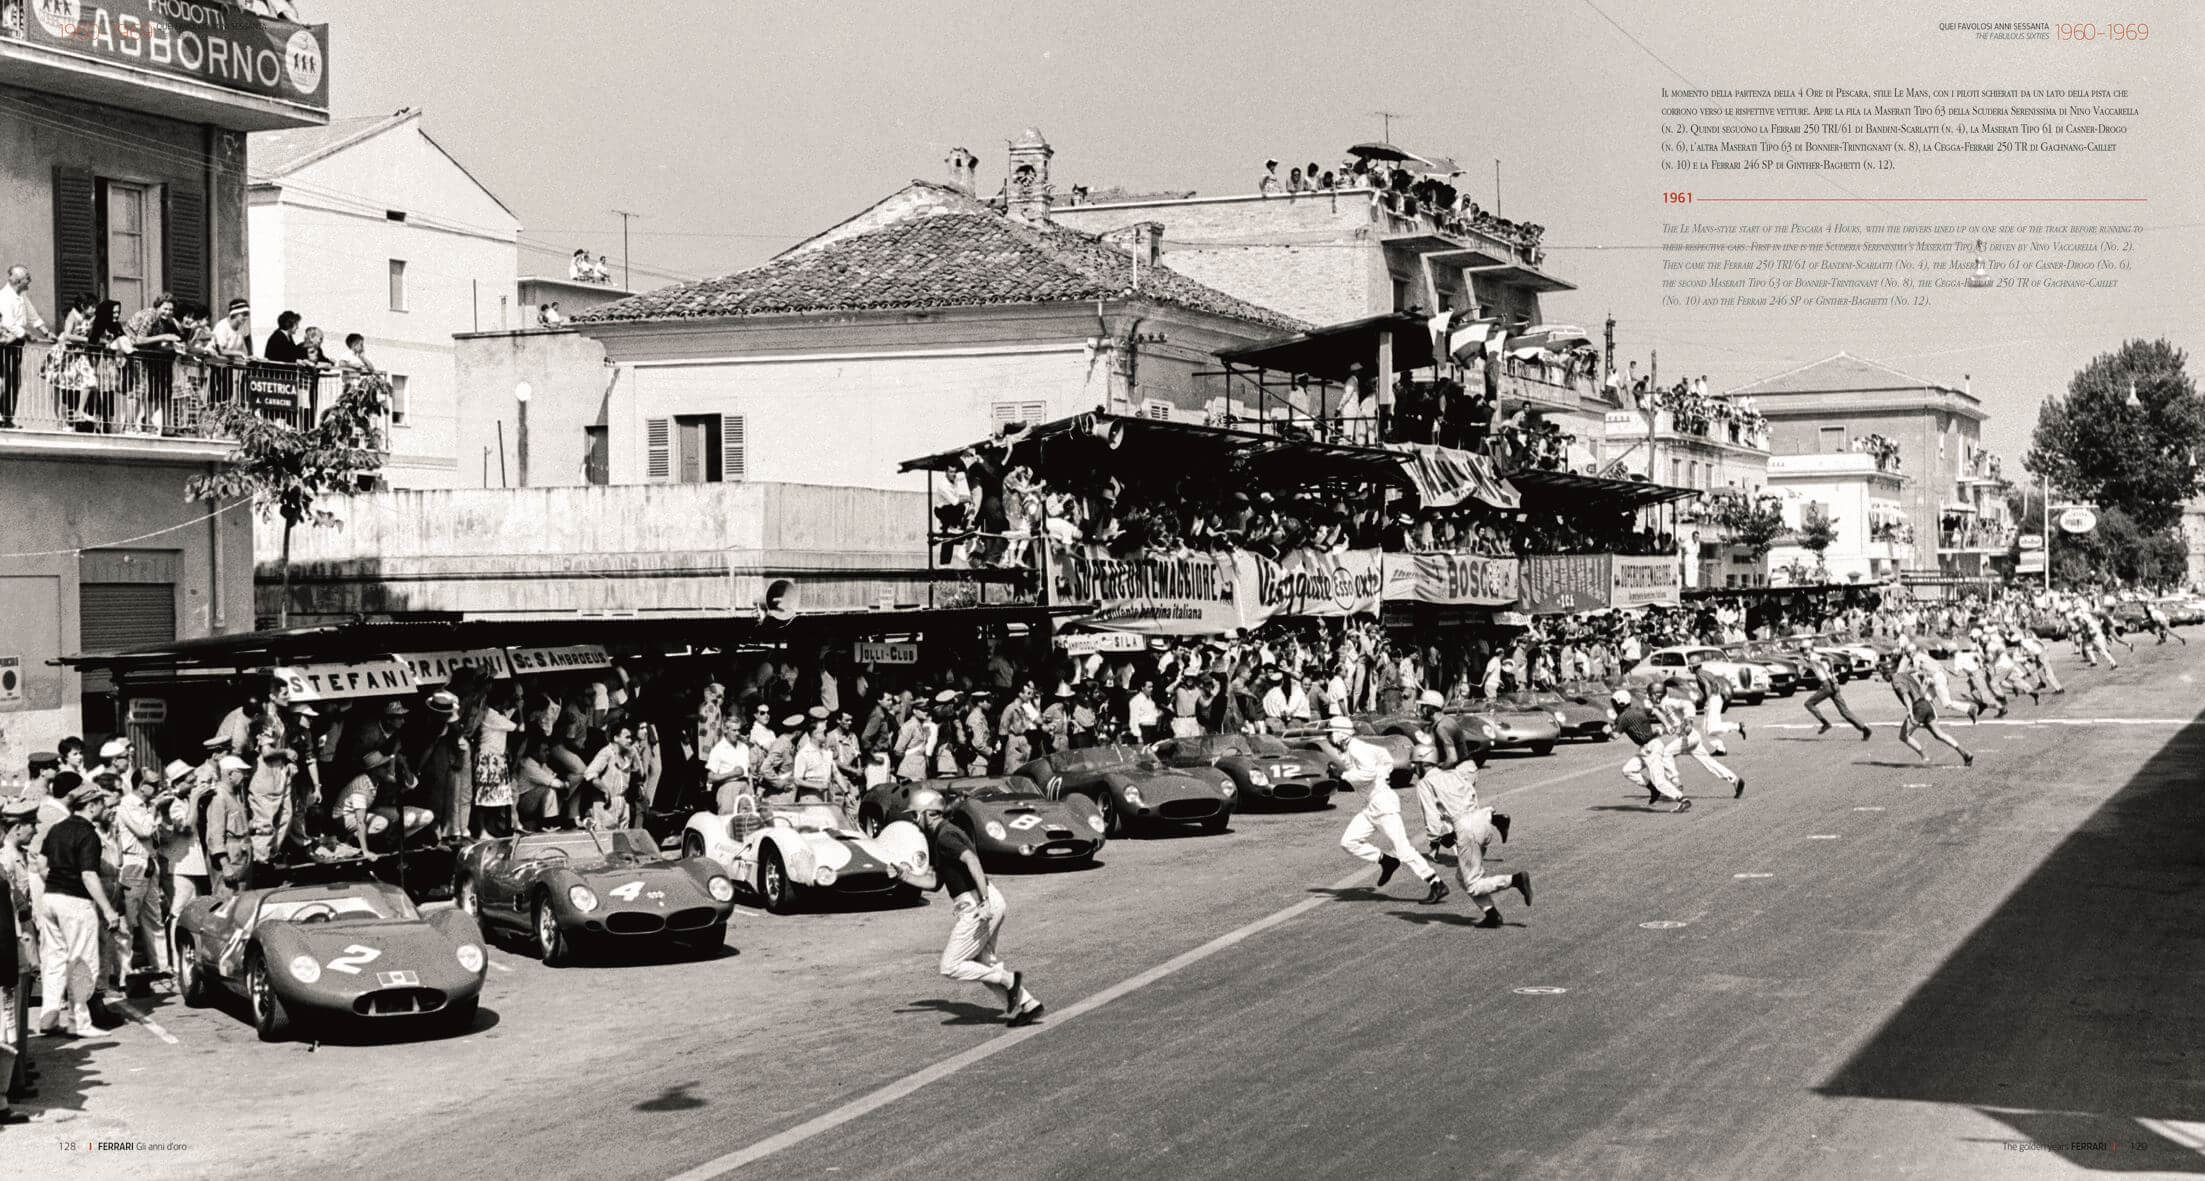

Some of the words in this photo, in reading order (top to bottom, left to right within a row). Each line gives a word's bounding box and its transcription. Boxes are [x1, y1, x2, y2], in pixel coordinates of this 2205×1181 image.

[91, 7, 280, 87] ASBORNO
[250, 380, 297, 395] OSTETRICA
[1334, 575, 1354, 598] Esso
[1446, 556, 1500, 600] BOSC
[1171, 602, 1202, 620] italiana
[1114, 635, 1139, 649] SILA
[290, 669, 410, 693] STEFANI
[1269, 763, 1302, 778] 12
[1009, 814, 1043, 831] 8
[609, 881, 646, 902] 4
[326, 944, 383, 975] 2
